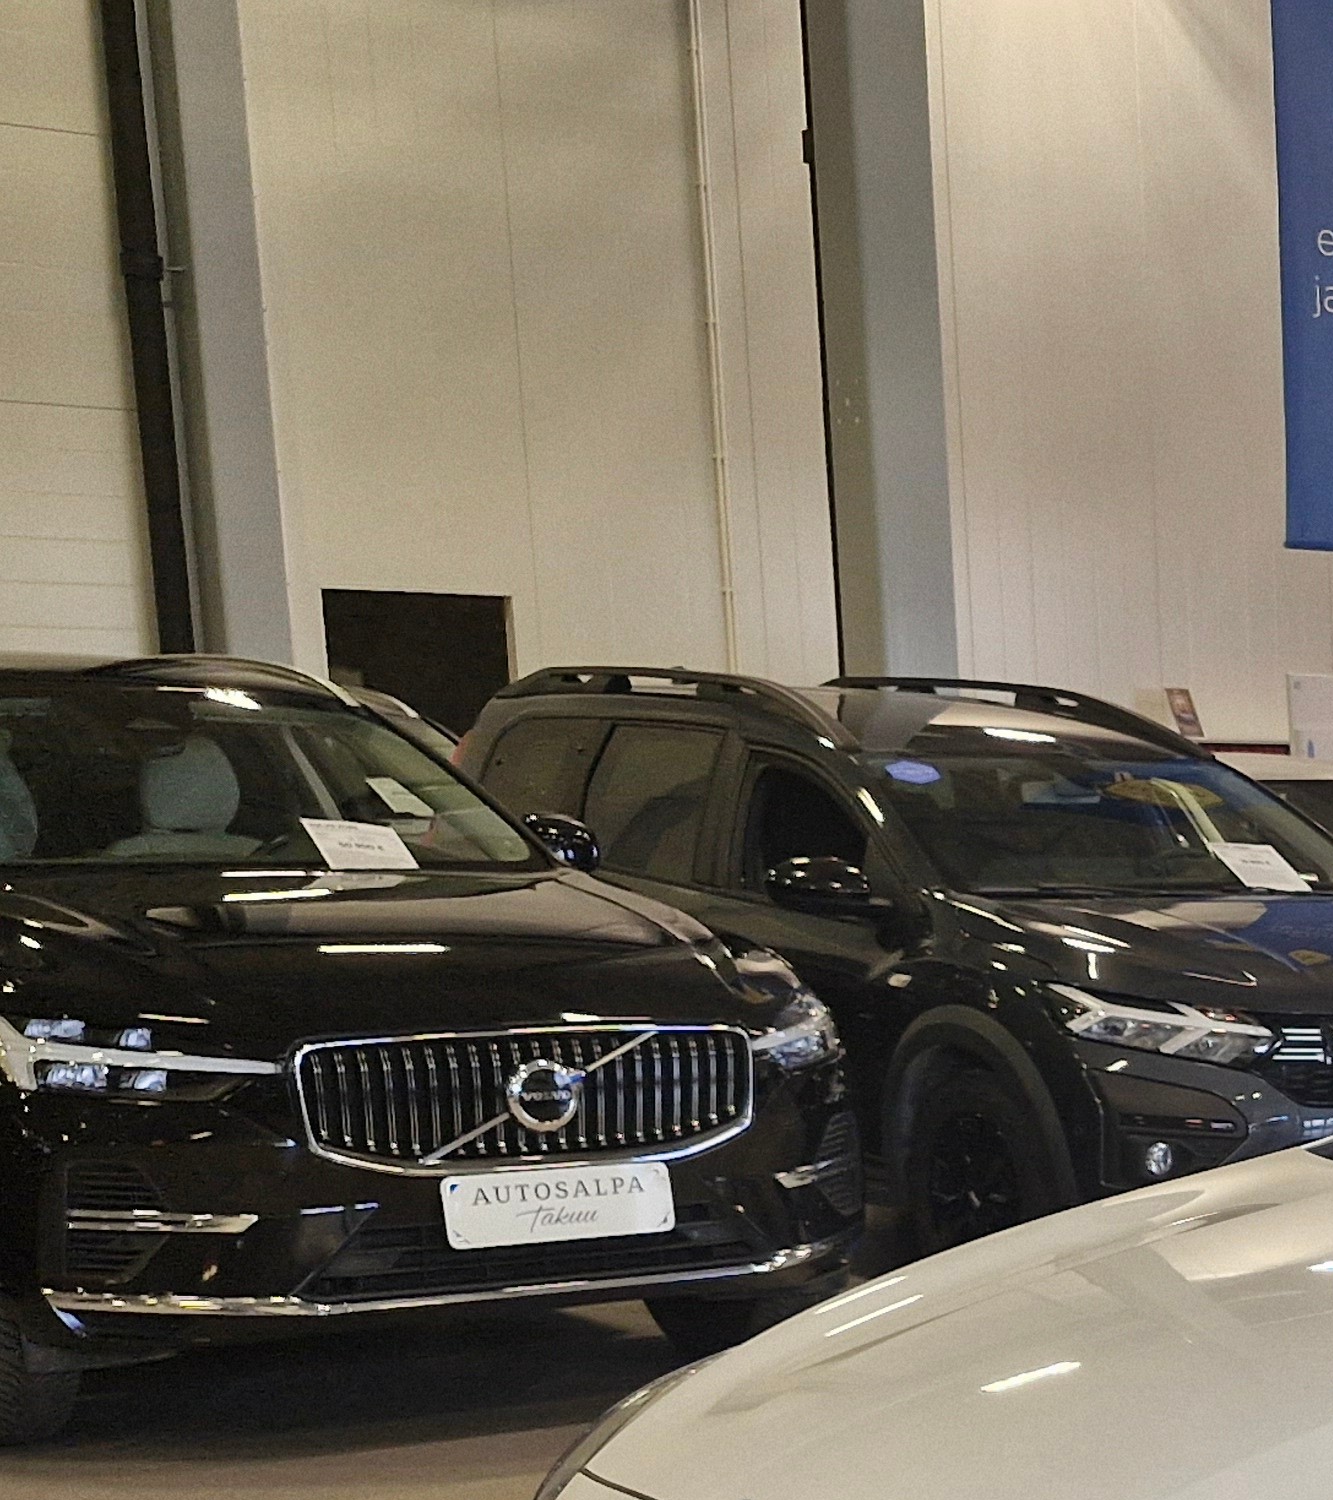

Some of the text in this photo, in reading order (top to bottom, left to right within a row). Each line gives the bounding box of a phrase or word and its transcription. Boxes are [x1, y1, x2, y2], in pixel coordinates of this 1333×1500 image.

[520, 1089, 572, 1102] VOLVO
[472, 1176, 645, 1207] AUTOSALPA
[515, 1205, 600, 1233] Takuu
